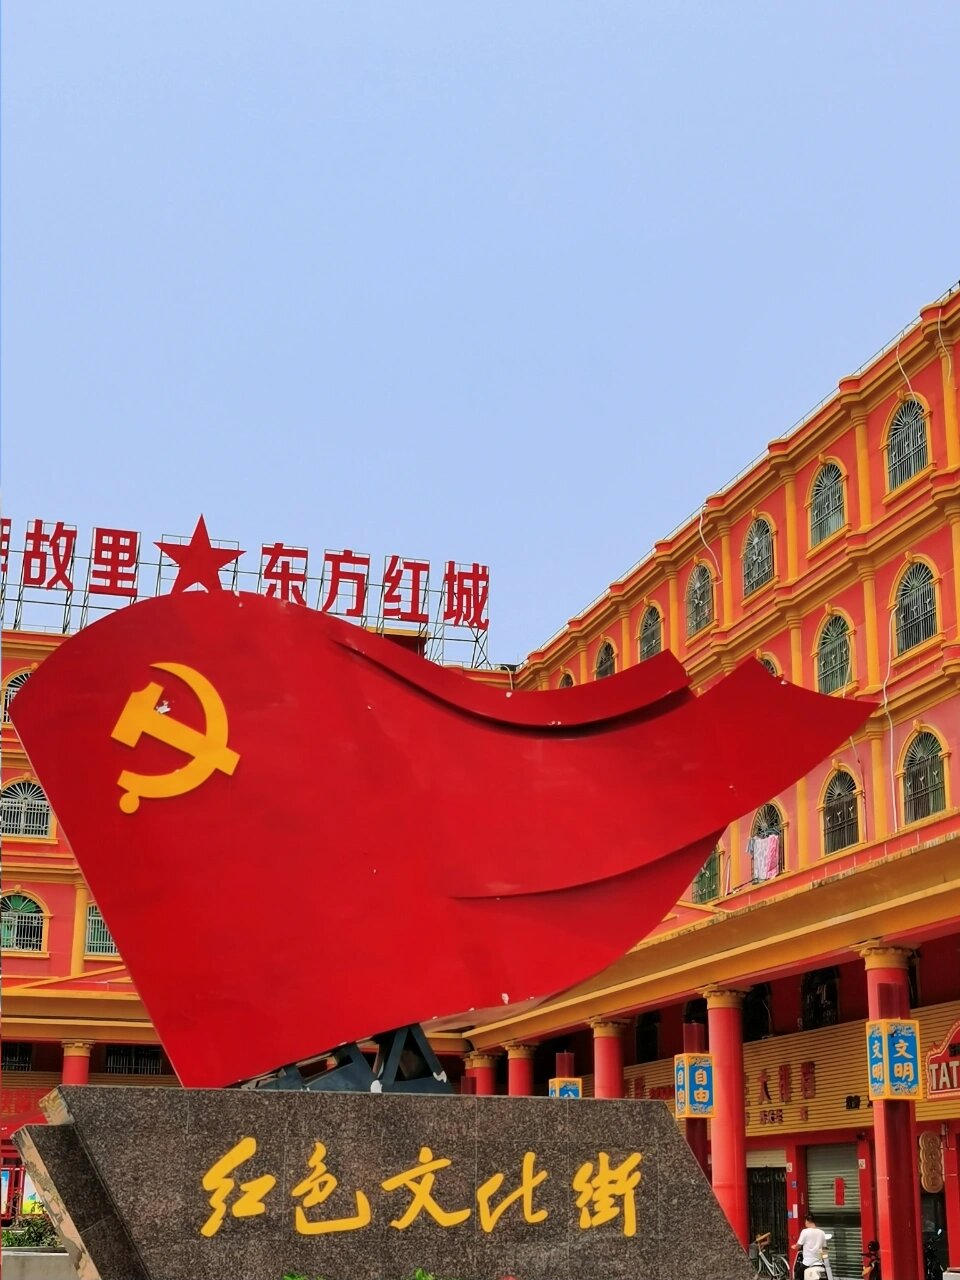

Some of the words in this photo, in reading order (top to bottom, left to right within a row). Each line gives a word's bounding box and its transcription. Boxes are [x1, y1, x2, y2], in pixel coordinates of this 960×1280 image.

[1, 518, 137, 597] 故里
[261, 543, 489, 630] 东方红城
[693, 1068, 709, 1102] 自由
[893, 1039, 915, 1082] 文明
[201, 1137, 643, 1238] 红色文化街
